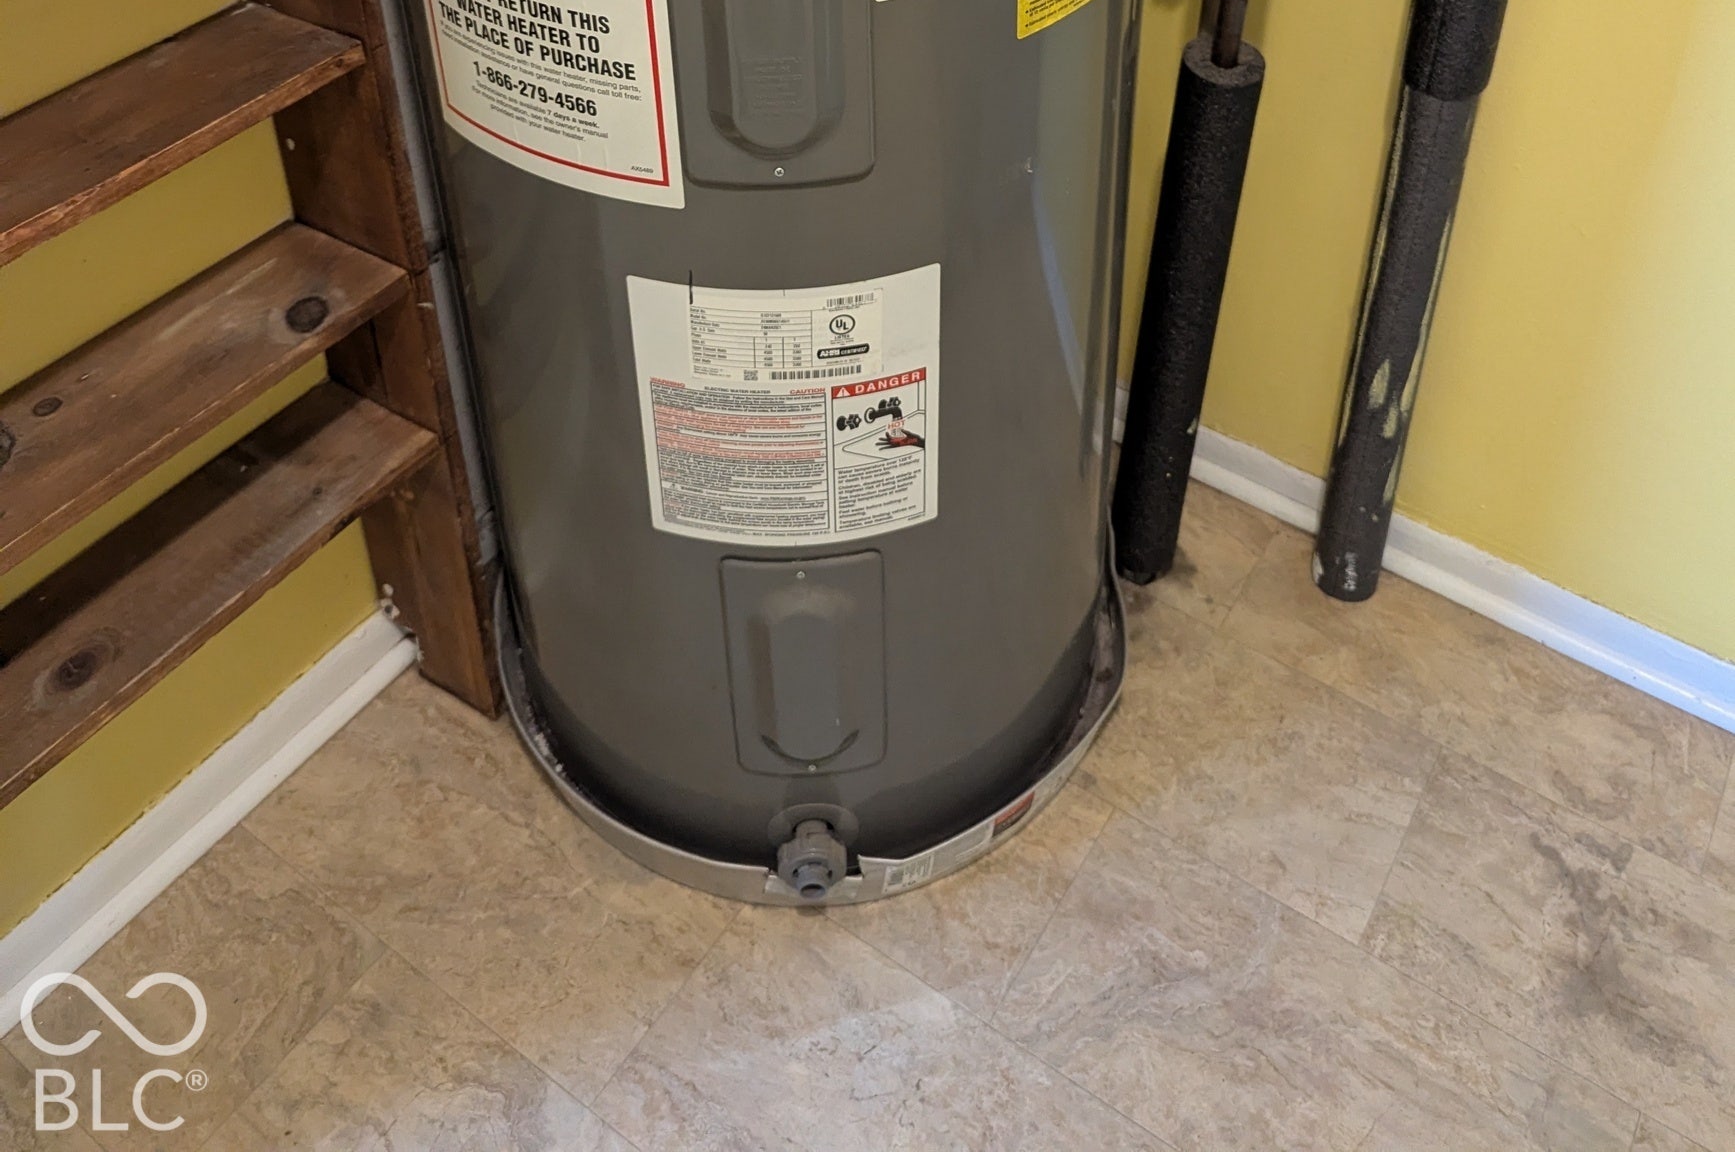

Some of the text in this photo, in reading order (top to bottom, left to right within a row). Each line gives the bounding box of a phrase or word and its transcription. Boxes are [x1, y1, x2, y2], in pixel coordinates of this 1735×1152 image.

[506, 13, 571, 47] HEATER
[576, 33, 600, 53] TO
[567, 9, 610, 34] THIS
[438, 0, 462, 28] THE
[464, 16, 510, 49] PLACE
[514, 36, 534, 56] OF
[539, 44, 636, 80] PURCHASE
[472, 60, 597, 116] 1-866-279-4566
[789, 387, 826, 395] CAUTION
[854, 370, 921, 394] DANGER
[888, 419, 905, 429] HOT
